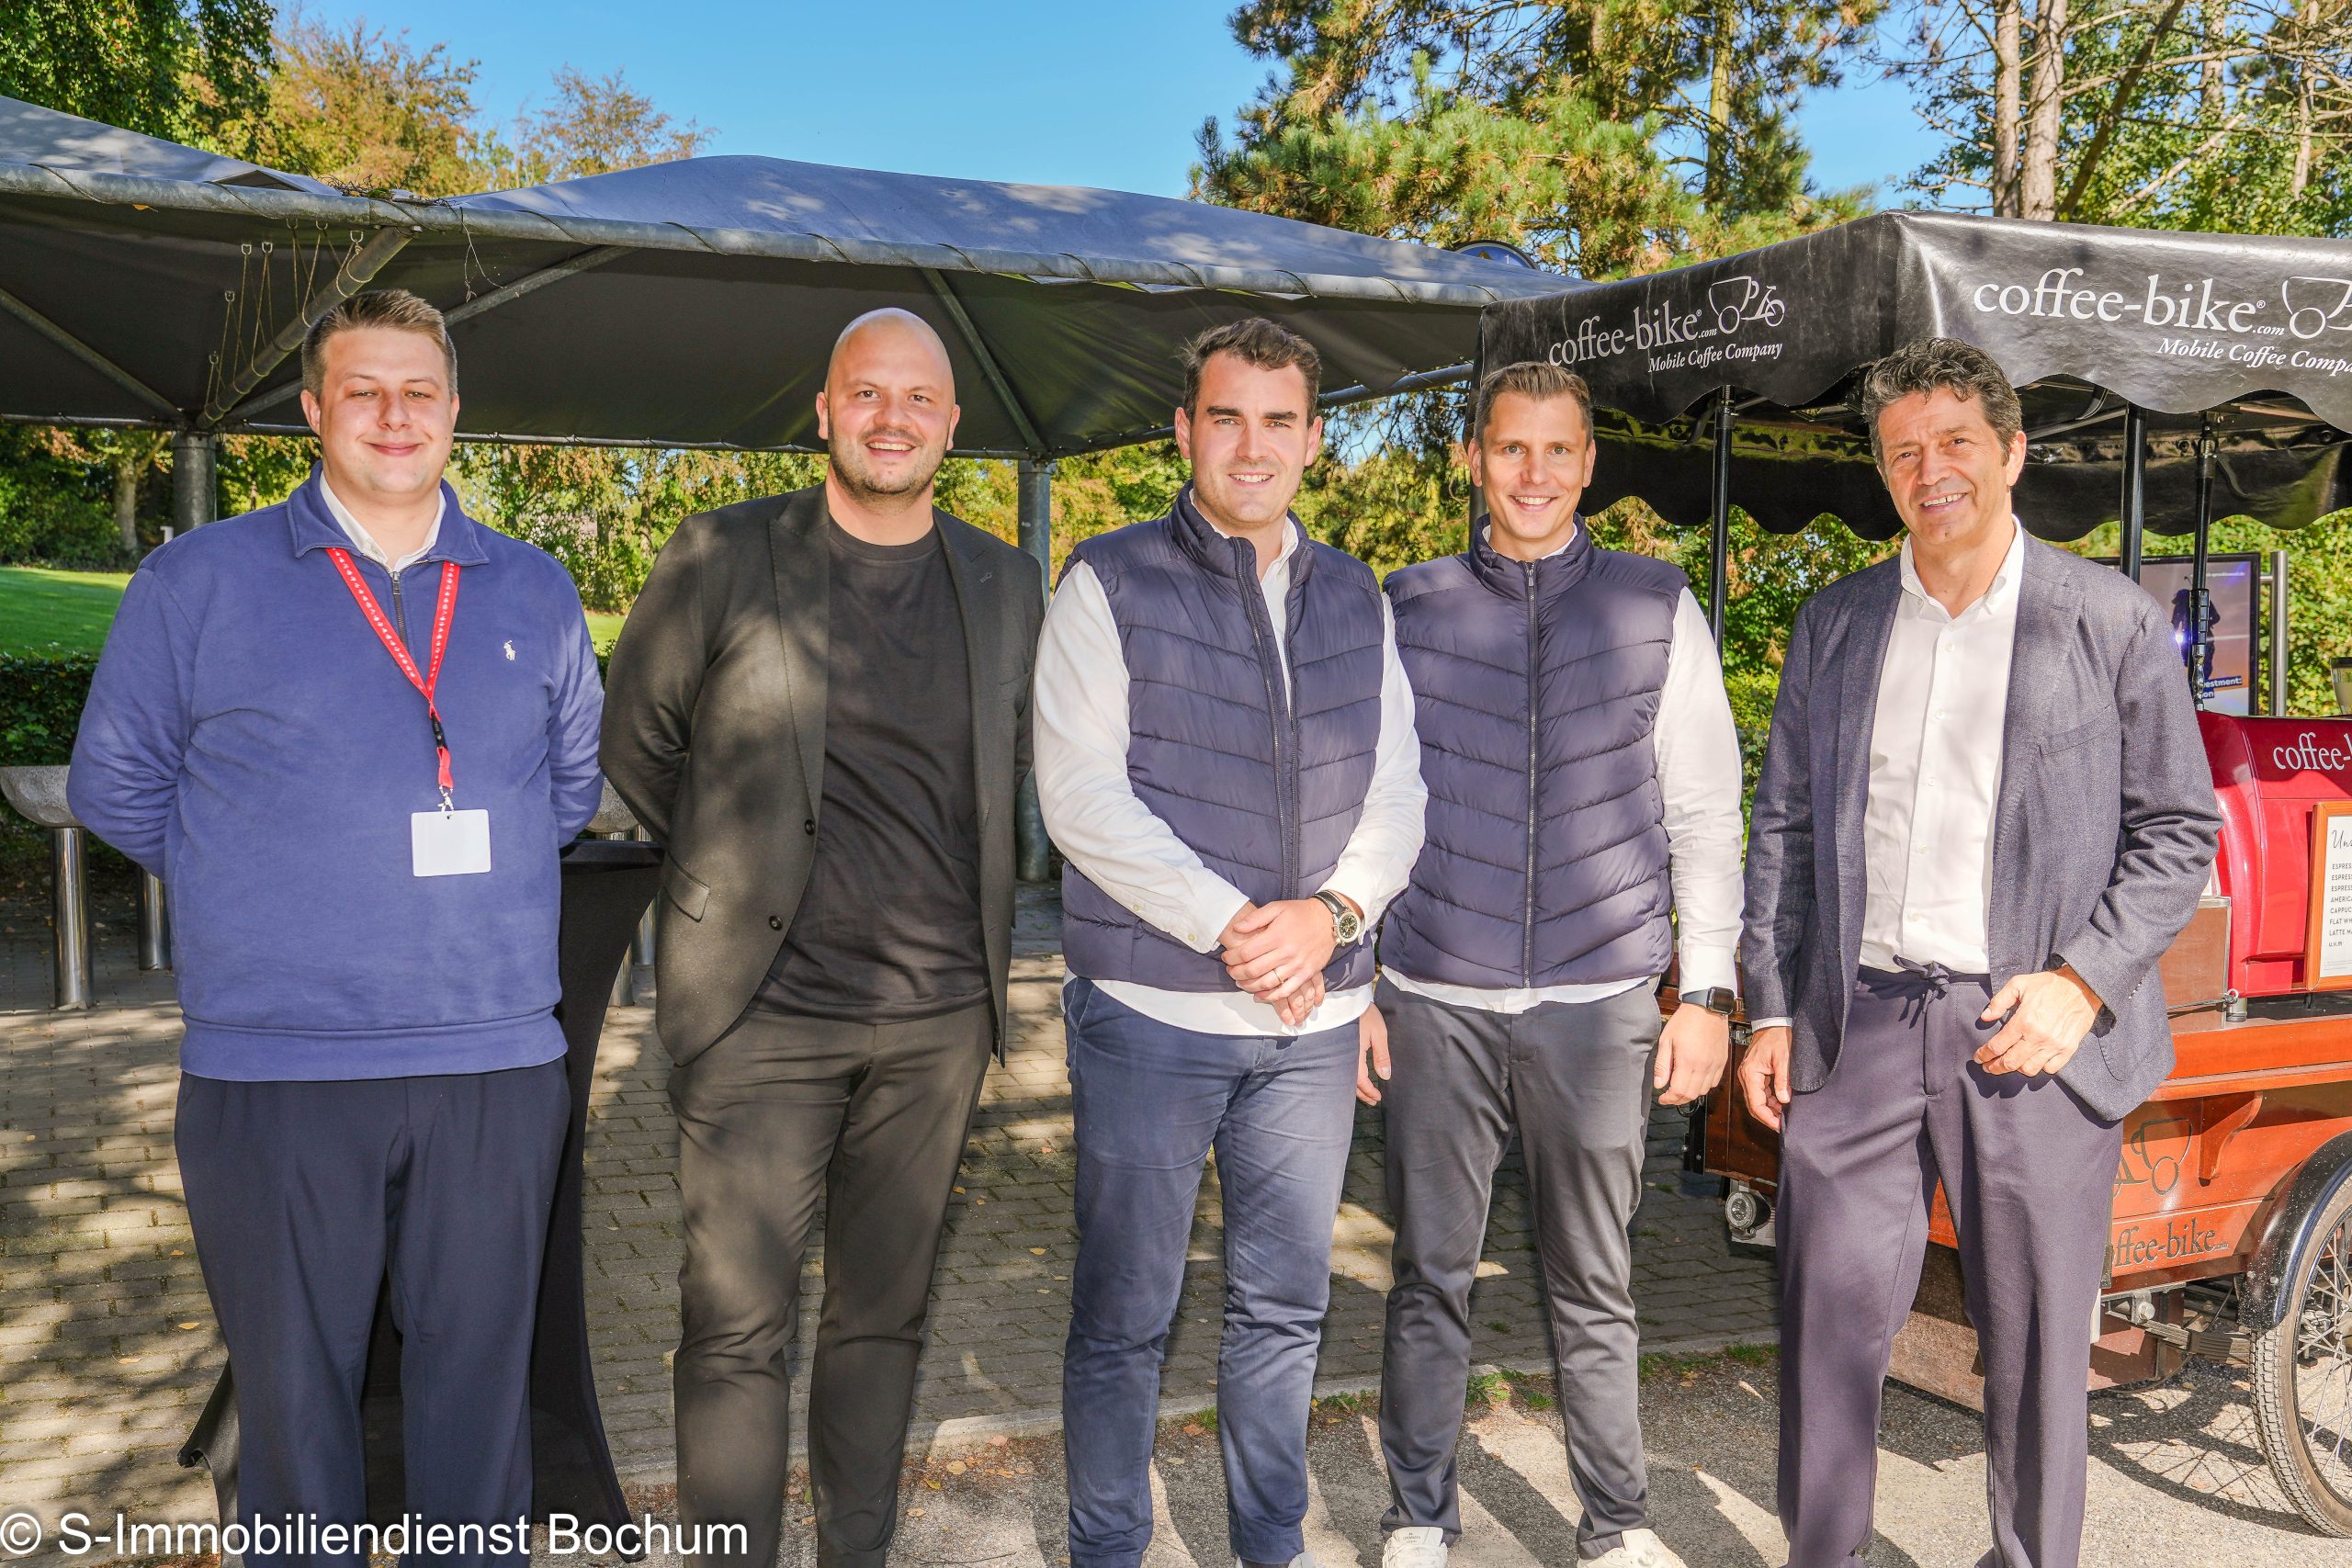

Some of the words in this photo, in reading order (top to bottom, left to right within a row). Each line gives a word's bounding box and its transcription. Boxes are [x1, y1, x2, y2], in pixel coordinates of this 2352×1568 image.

[1648, 351, 1686, 373] Mobile
[1688, 345, 1723, 369] Coffee
[1724, 343, 1783, 362] Company
[2155, 337, 2224, 360] Mobile
[2228, 344, 2287, 368] Coffee
[2111, 1217, 2215, 1268] ffee-bike
